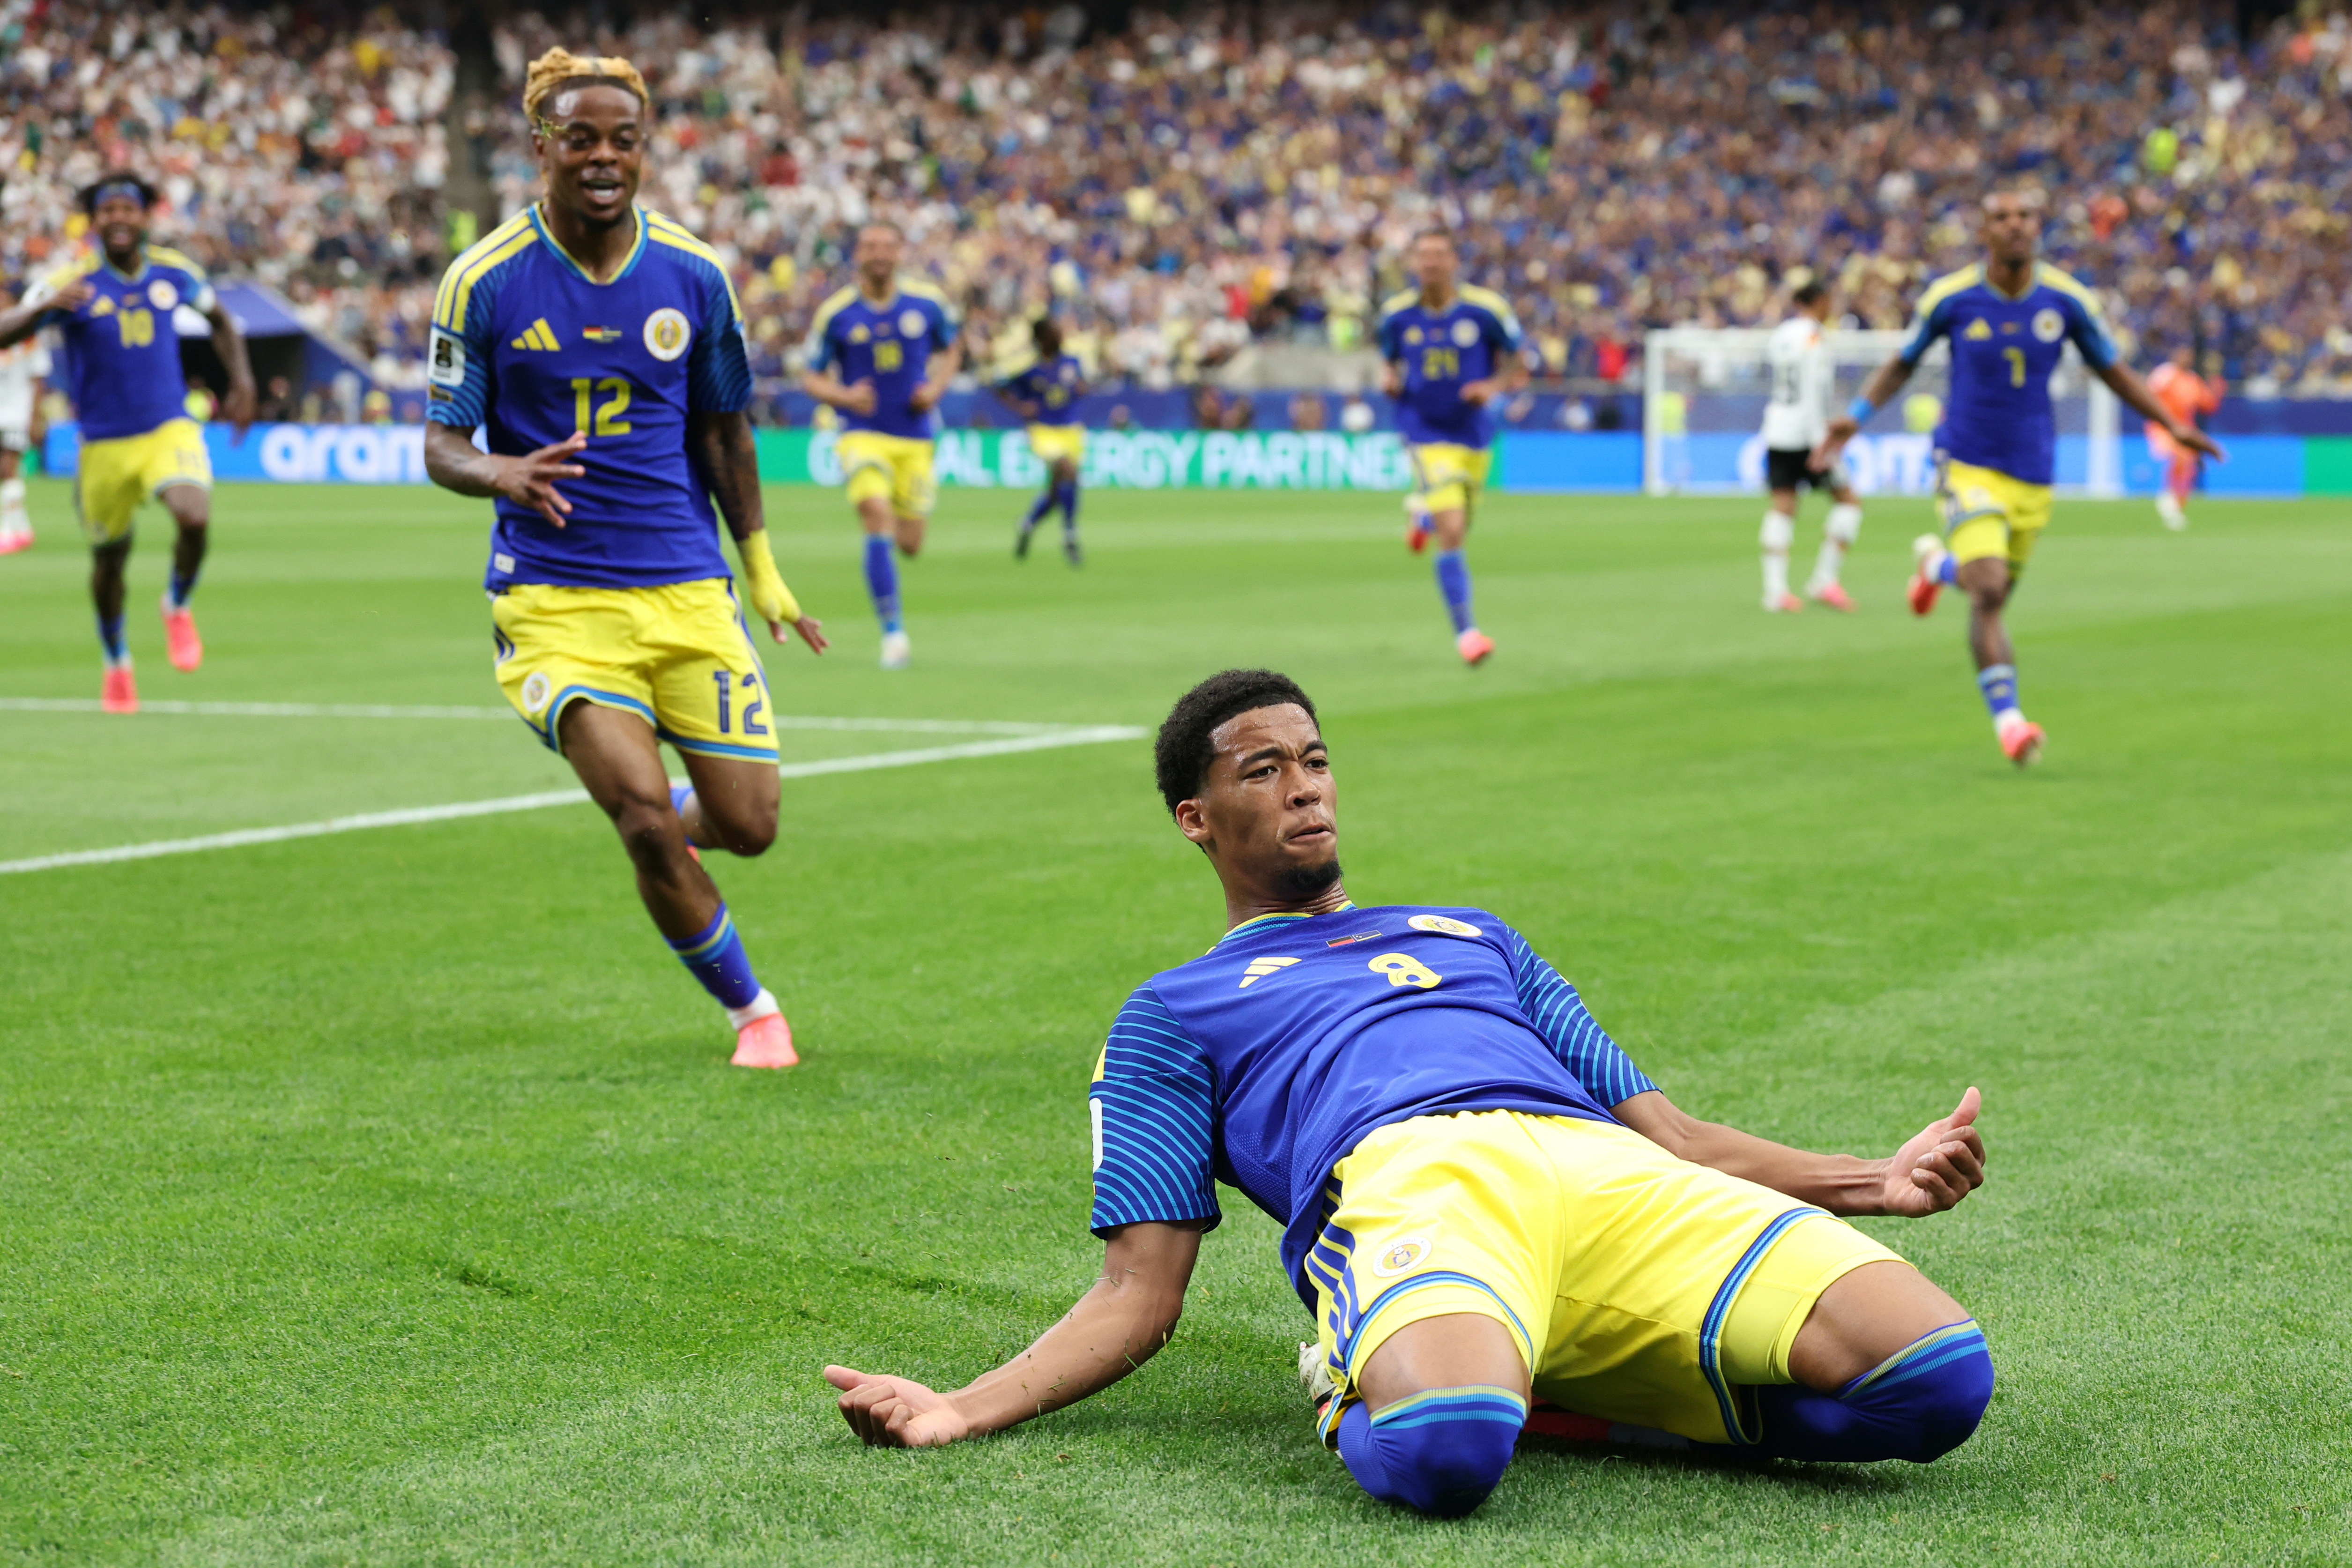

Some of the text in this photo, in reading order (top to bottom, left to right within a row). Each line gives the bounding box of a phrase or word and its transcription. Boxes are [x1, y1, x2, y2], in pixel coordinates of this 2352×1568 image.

[571, 377, 631, 438] 12
[999, 428, 1200, 489] EERGY
[713, 670, 768, 735] 12
[1367, 952, 1444, 989] 8
